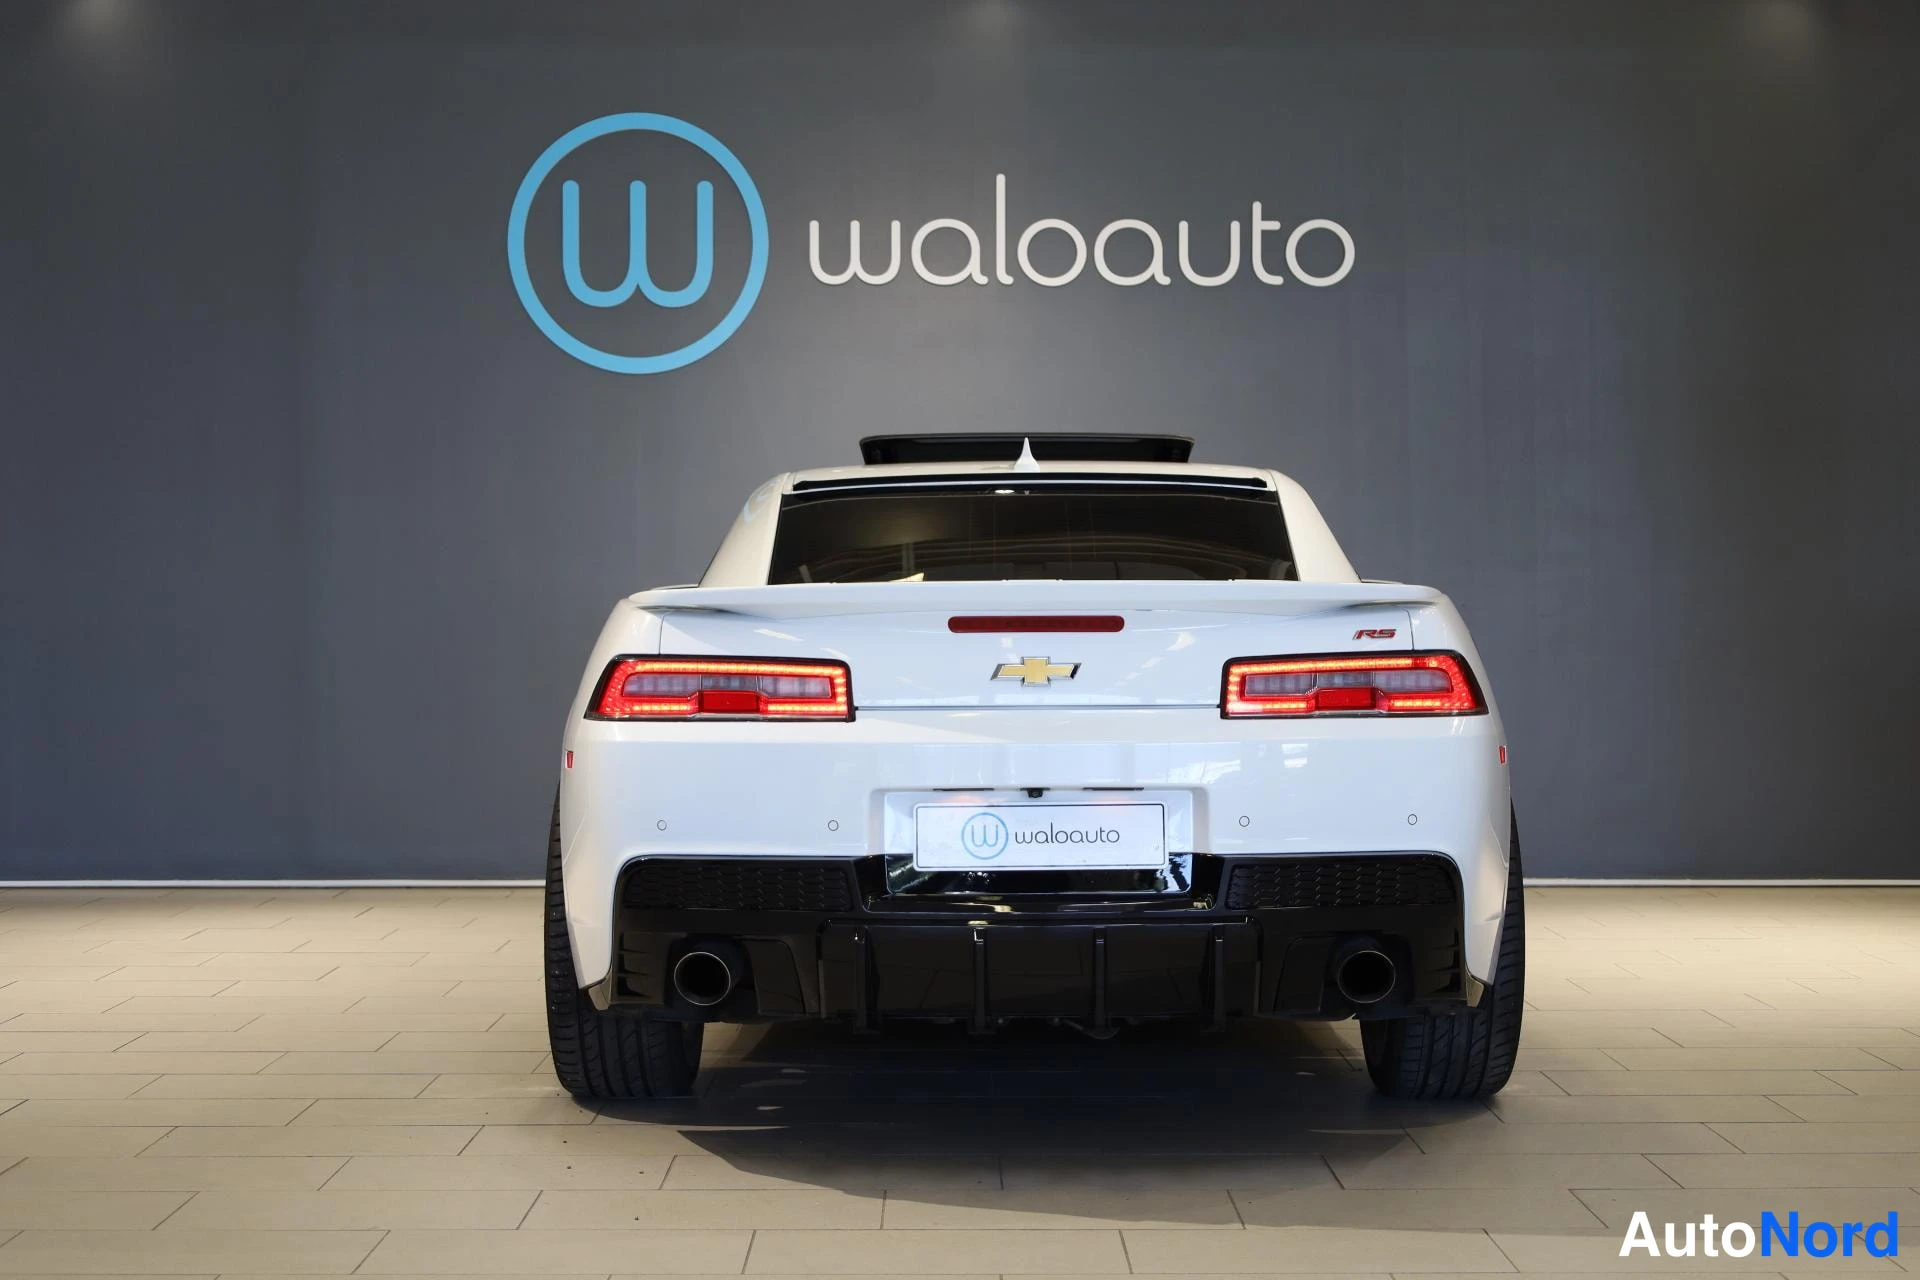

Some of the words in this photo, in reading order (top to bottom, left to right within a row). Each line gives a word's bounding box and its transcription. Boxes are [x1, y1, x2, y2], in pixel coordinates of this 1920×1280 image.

[808, 173, 1356, 287] waloauto
[1354, 628, 1397, 640] RS
[1015, 822, 1120, 844] waloauto
